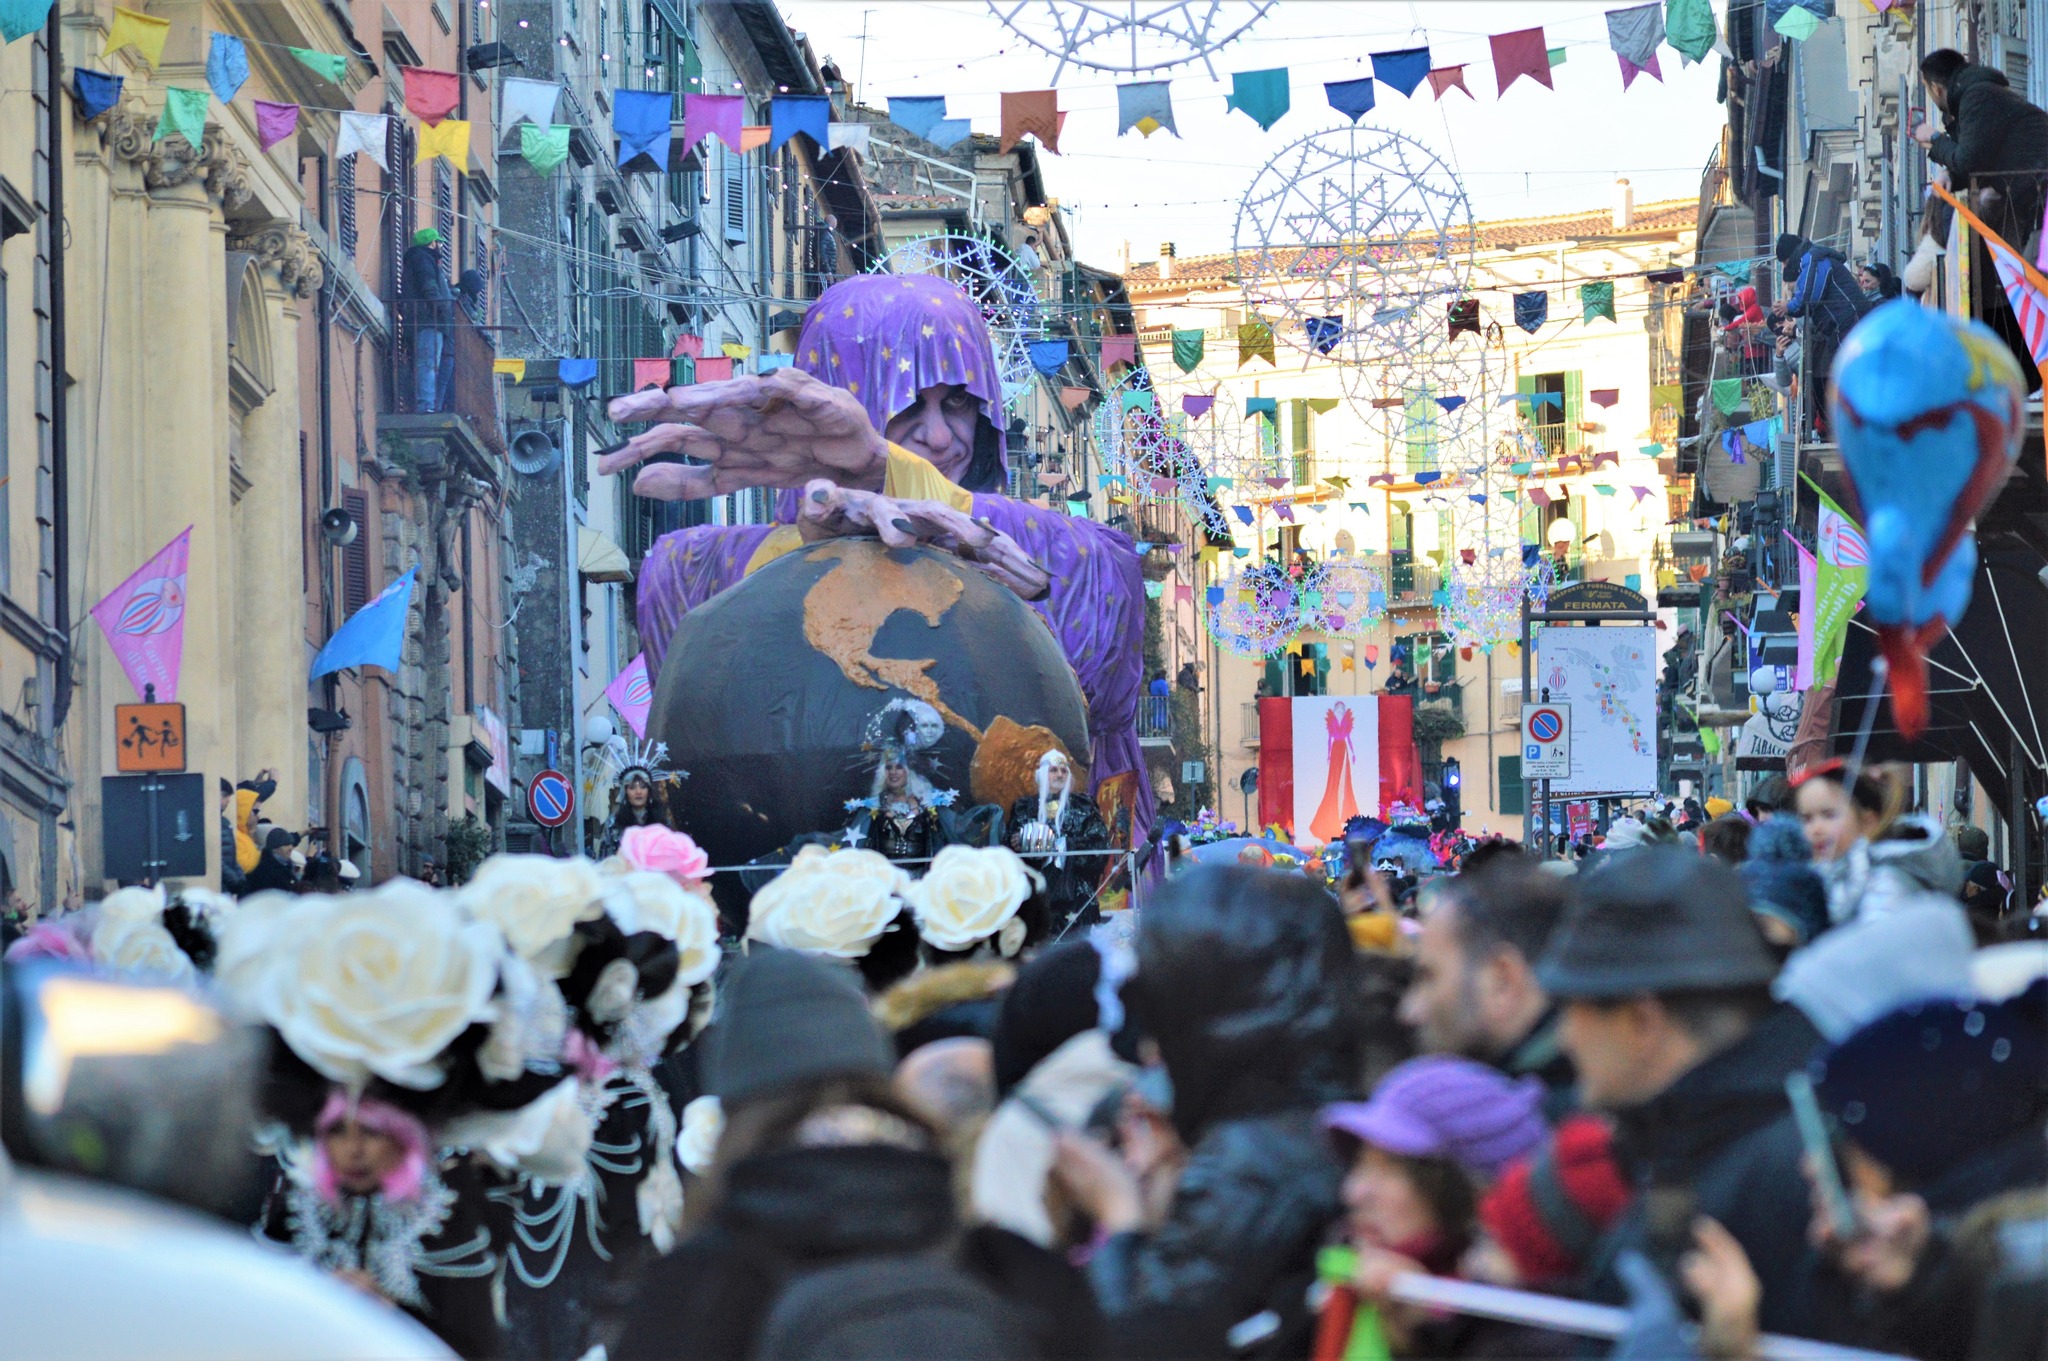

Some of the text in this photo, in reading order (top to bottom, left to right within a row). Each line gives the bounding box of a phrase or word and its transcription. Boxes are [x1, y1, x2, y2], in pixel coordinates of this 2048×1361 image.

[1550, 584, 1584, 602] TRASPORTO
[1587, 583, 1618, 591] PUBBLICO
[1620, 588, 1644, 604] LOCALE
[1564, 601, 1627, 609] FERMATA
[1528, 746, 1538, 758] P
